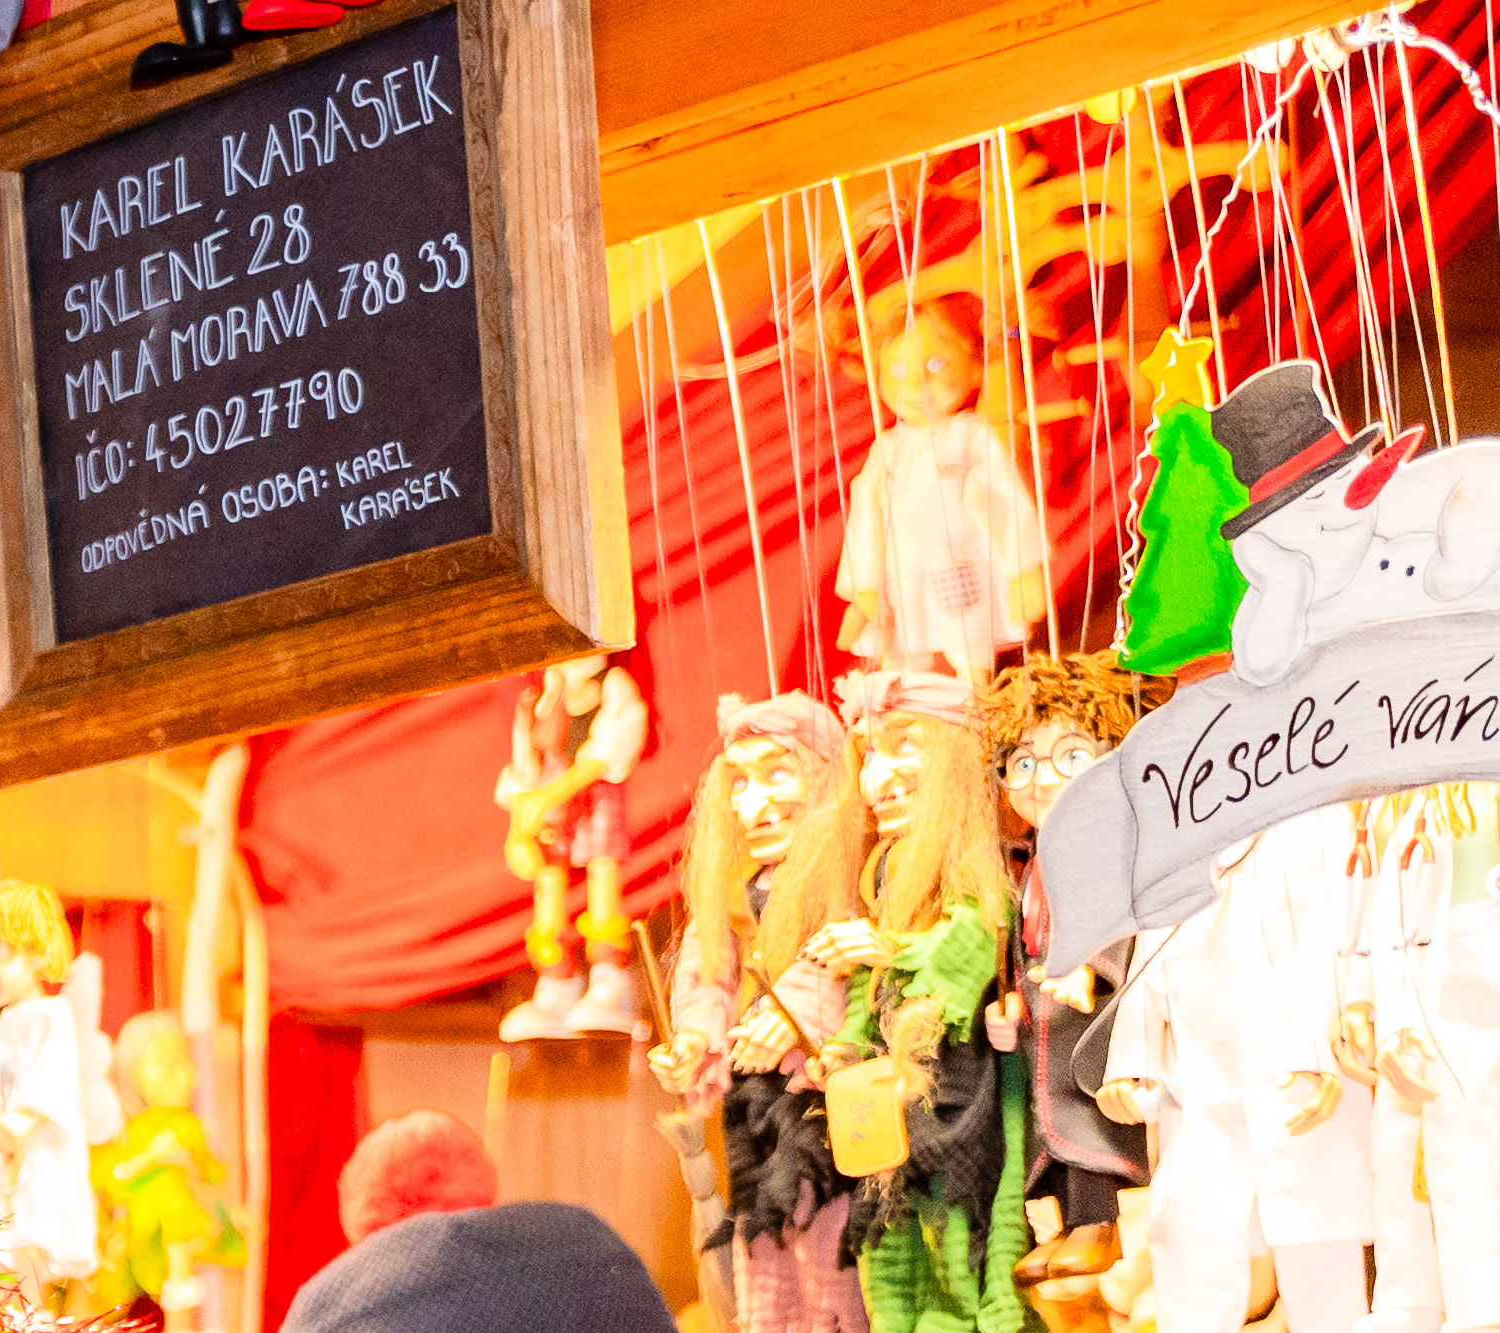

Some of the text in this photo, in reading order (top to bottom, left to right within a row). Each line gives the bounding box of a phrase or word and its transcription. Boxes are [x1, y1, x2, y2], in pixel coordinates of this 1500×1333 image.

[61, 54, 454, 260] KAREL KARÁSEK
[64, 203, 312, 343] SKLENÉ 28
[65, 232, 470, 421] MALÁ MORAVA 788 33
[76, 366, 365, 500] IČO: 45027790
[341, 467, 460, 531] KARÁSEK
[80, 441, 413, 573] ODPOVĚDNÁ OSOBA: KAREL
[1142, 680, 1360, 830] Veselé
